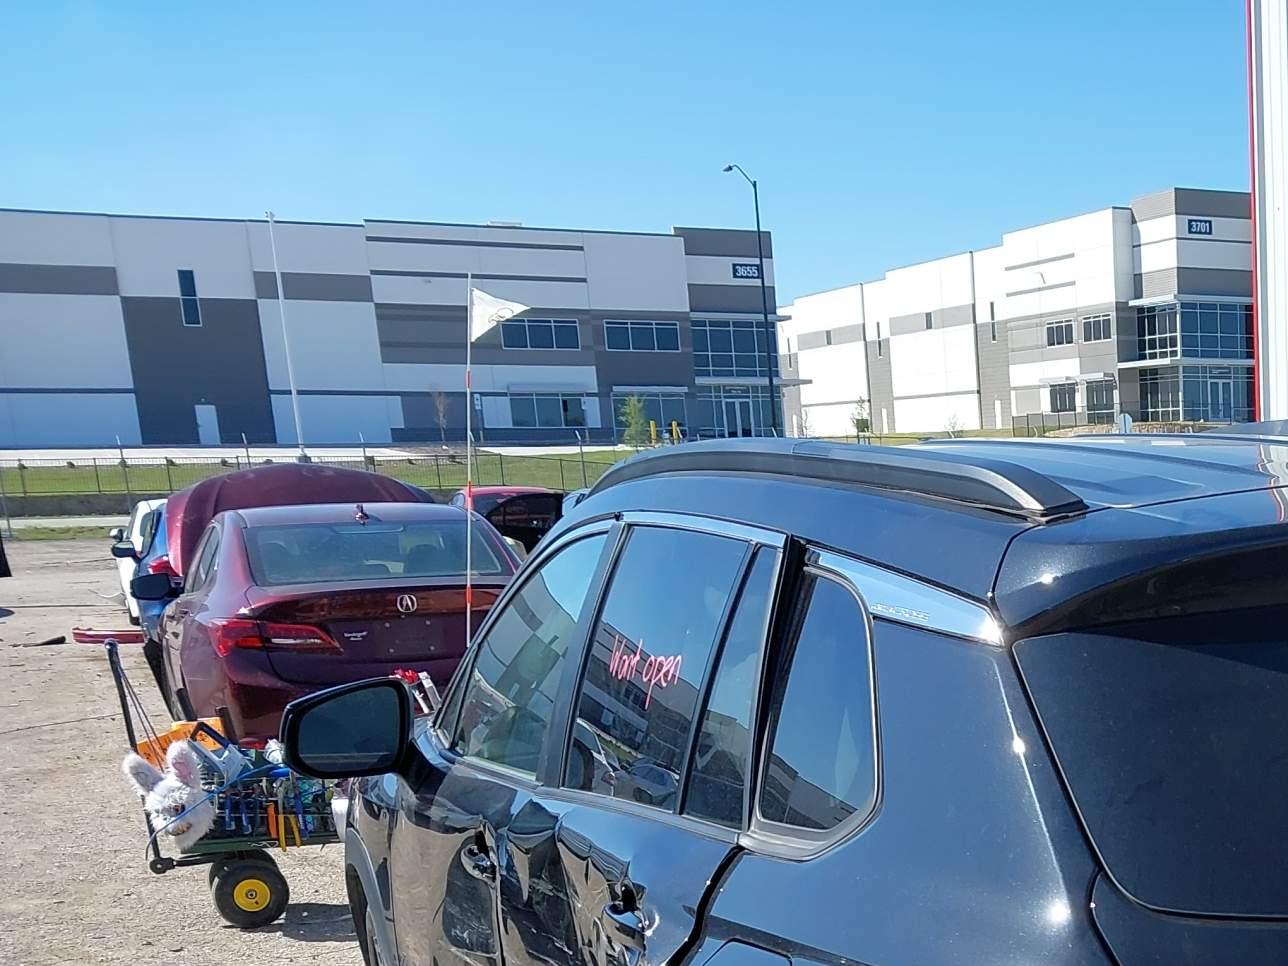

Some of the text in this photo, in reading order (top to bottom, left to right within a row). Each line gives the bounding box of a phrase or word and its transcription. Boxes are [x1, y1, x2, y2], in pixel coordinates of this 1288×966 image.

[1190, 221, 1210, 233] 3701
[735, 265, 759, 277] 3655
[642, 654, 682, 711] open
